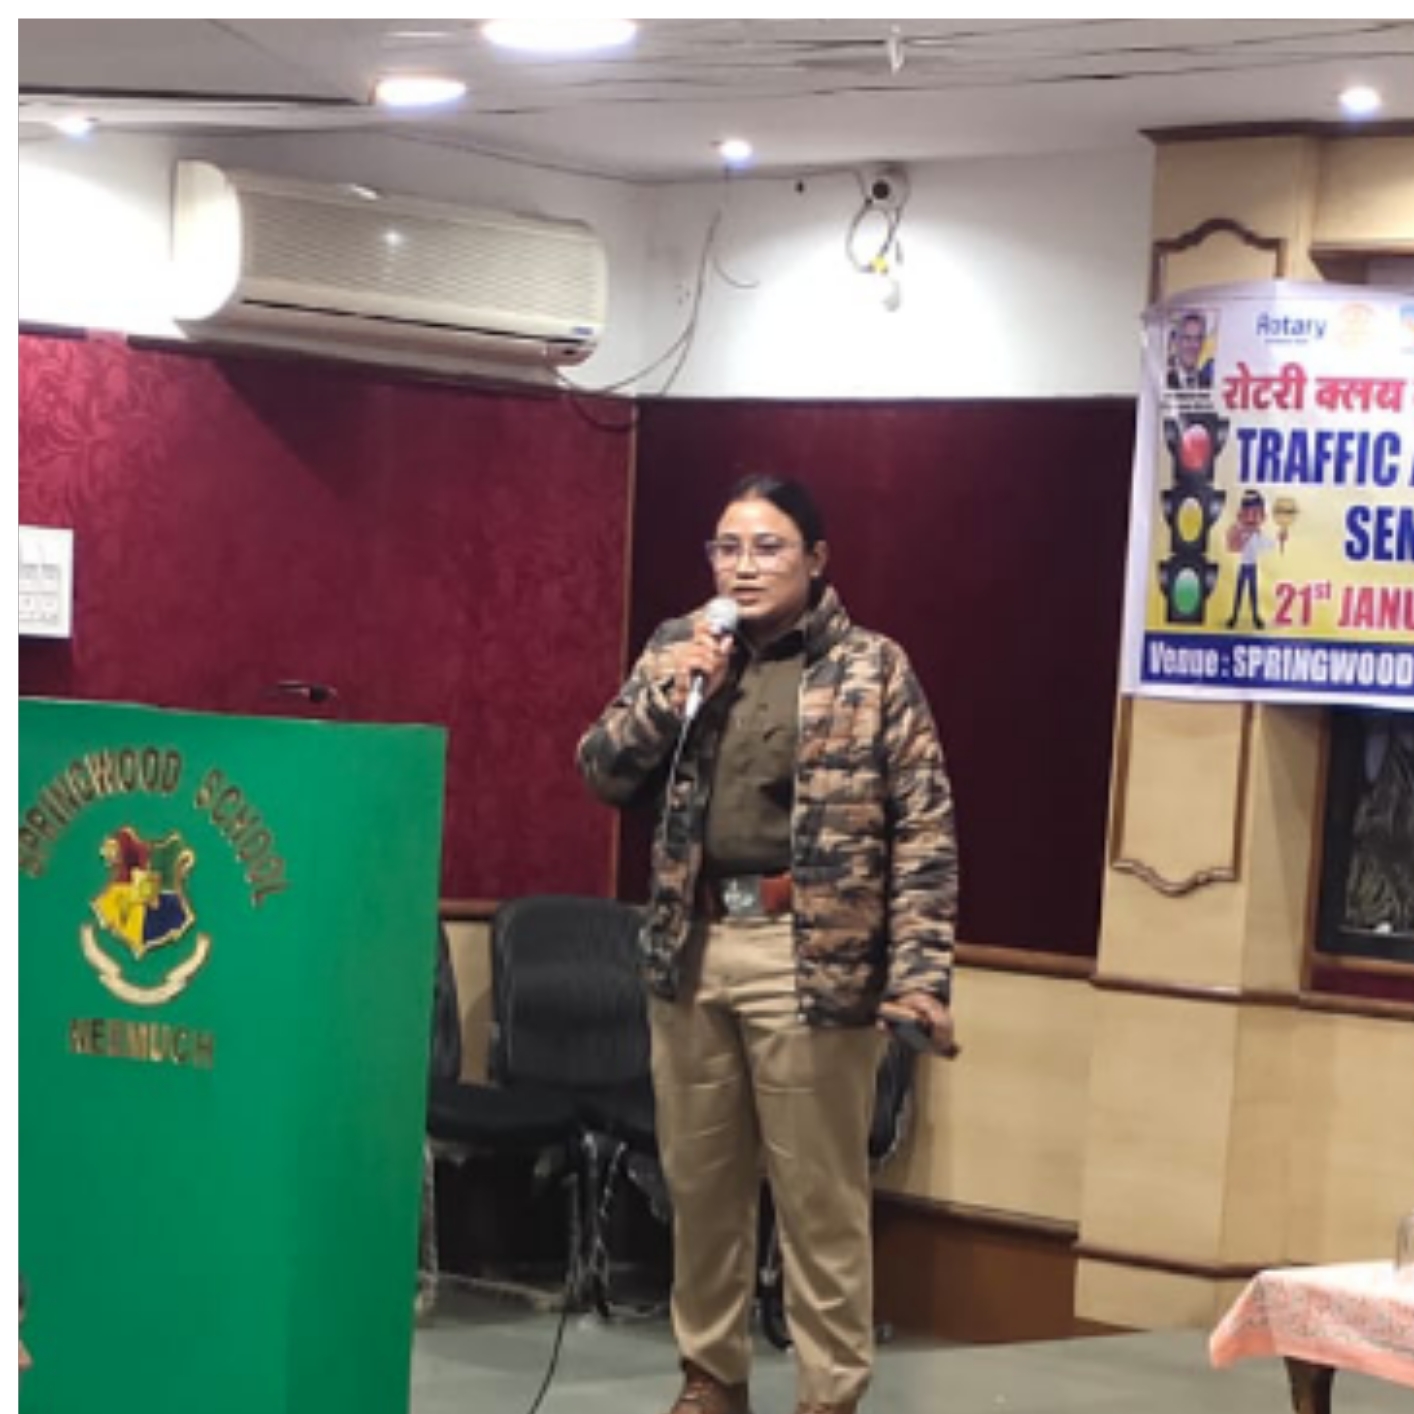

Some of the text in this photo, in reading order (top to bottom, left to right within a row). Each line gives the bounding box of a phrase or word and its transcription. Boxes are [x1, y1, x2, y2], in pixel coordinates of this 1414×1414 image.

[1256, 311, 1327, 338] Rotary
[1222, 362, 1307, 412] रोटरी
[1236, 428, 1400, 487] TRAFFIC
[1274, 579, 1333, 626] 21st
[1149, 641, 1220, 677] Venue
[194, 768, 290, 909] SCHOOL
[69, 1017, 214, 1070] NEEMUCH
